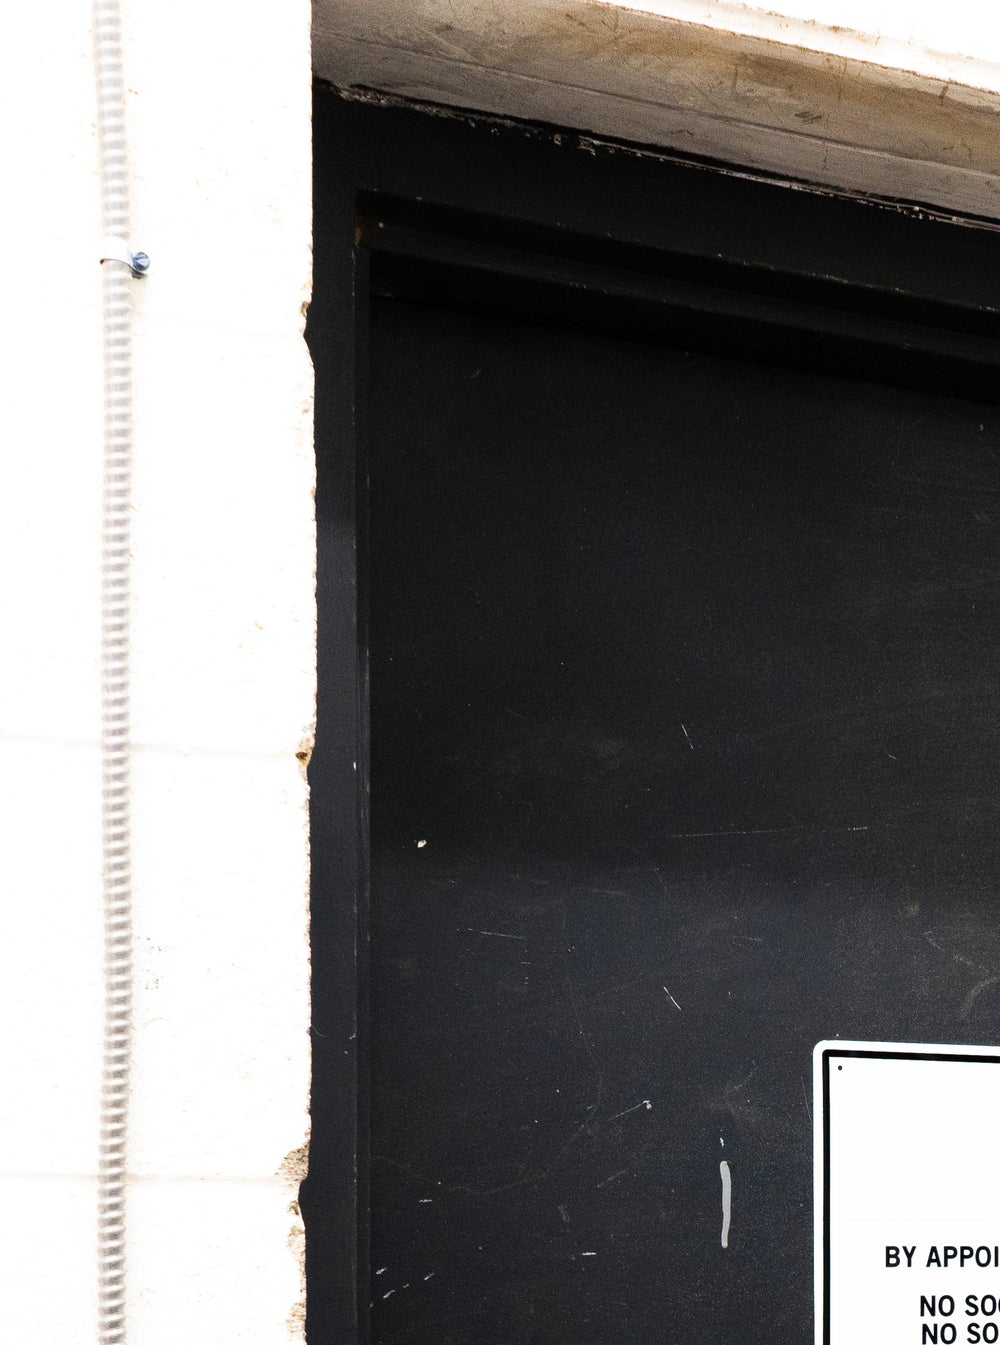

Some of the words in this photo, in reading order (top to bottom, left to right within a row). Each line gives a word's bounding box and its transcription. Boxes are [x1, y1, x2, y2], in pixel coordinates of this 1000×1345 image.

[886, 1246, 916, 1267] BY
[920, 1295, 955, 1317] NO
[922, 1323, 957, 1345] NO
